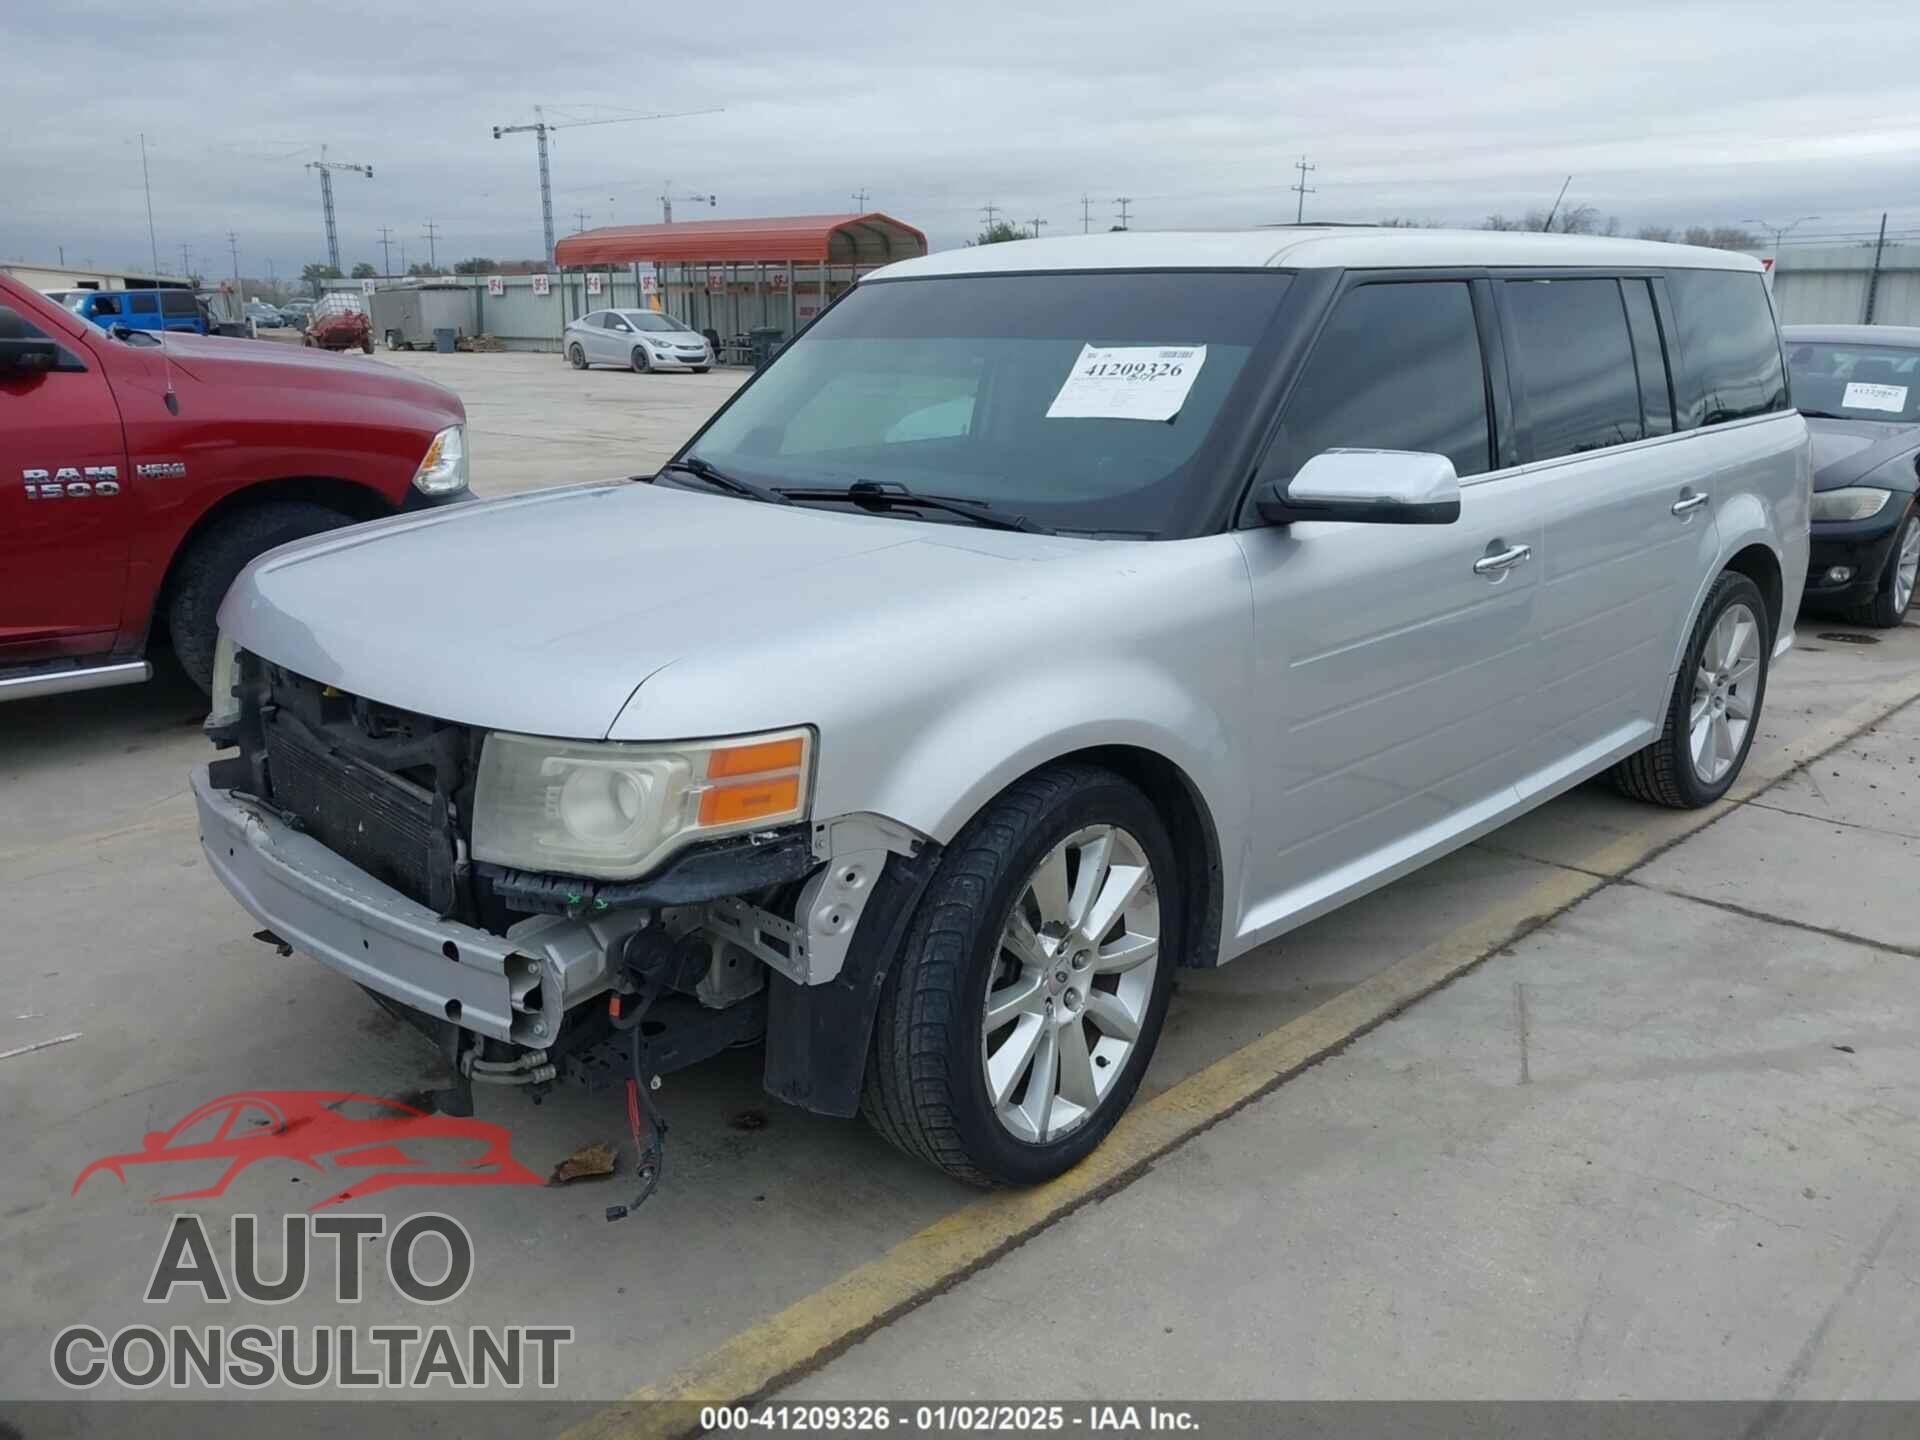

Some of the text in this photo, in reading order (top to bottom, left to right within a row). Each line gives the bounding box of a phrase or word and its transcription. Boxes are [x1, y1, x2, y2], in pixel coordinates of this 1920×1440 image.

[1085, 362, 1182, 377] 41209326
[22, 466, 118, 482] RAM
[136, 462, 186, 479] HEMI
[24, 482, 120, 498] 1500
